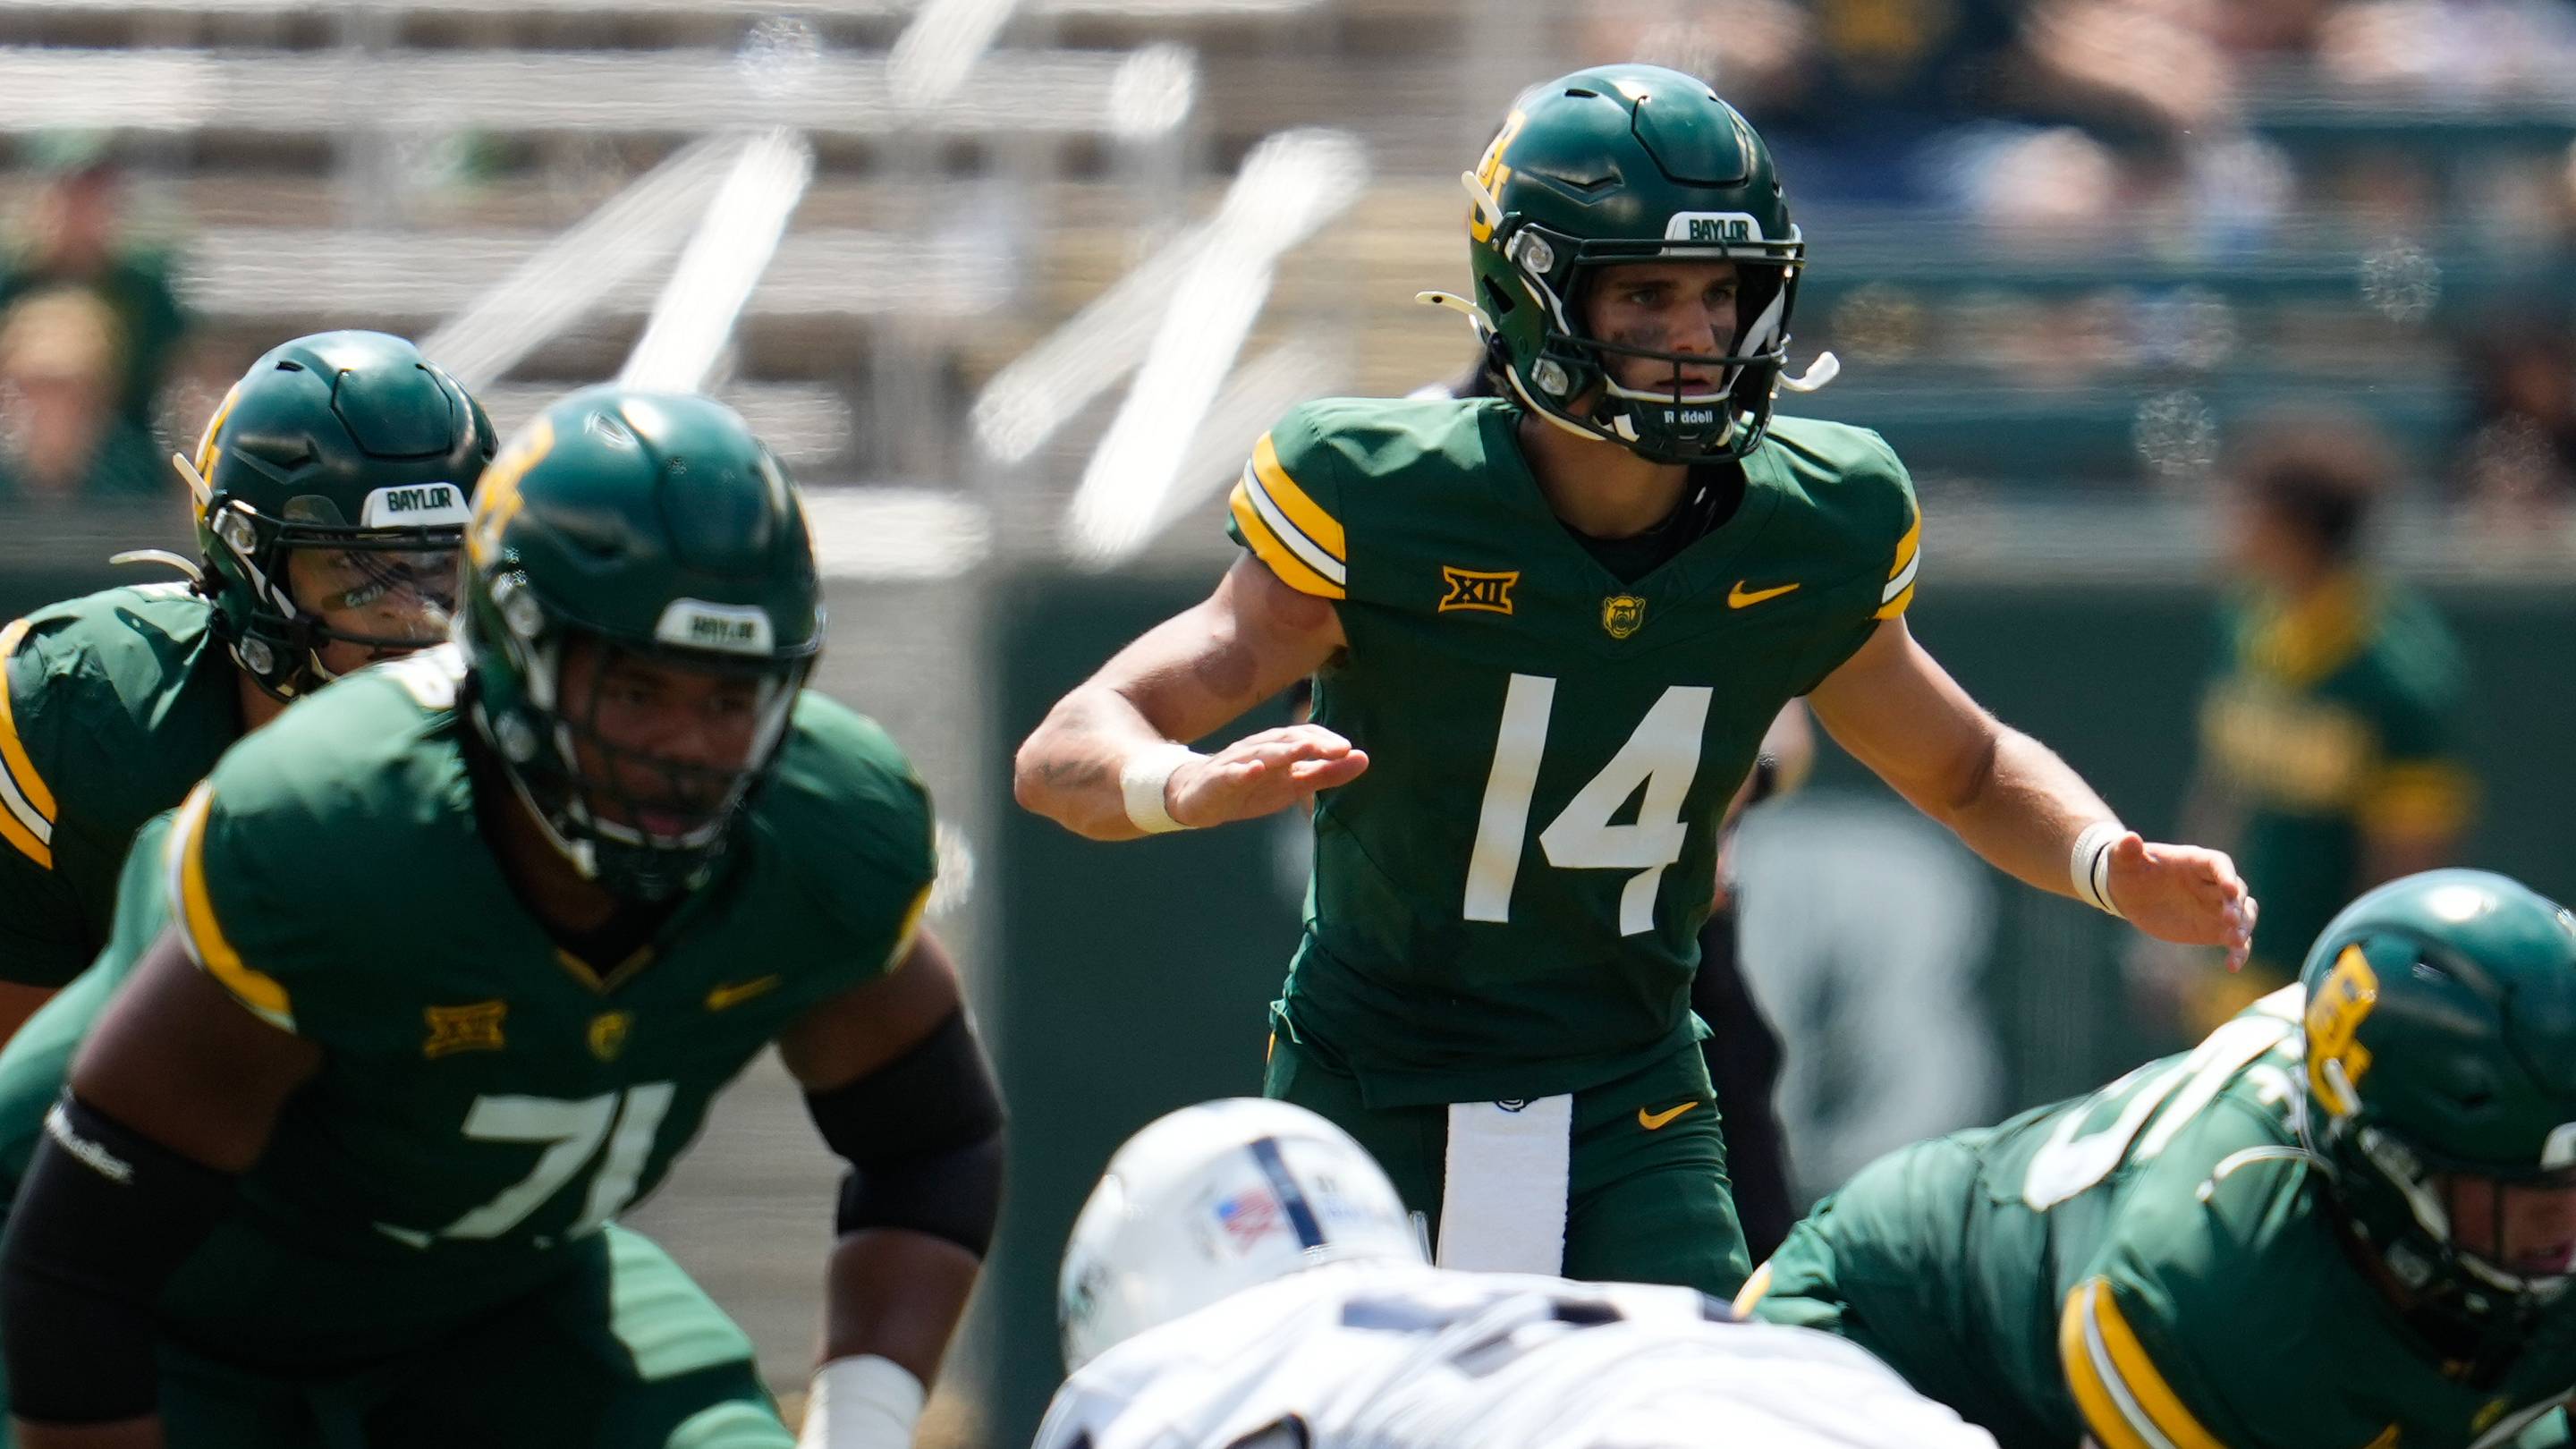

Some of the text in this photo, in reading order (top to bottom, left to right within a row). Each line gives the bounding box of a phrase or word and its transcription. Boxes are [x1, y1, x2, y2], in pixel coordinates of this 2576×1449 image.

[1689, 218, 1750, 242] BAYLOR
[1664, 411, 1714, 424] Rddell
[386, 487, 453, 512] BAYLOR
[1463, 673, 1714, 936] 14
[447, 1080, 677, 1241] 71
